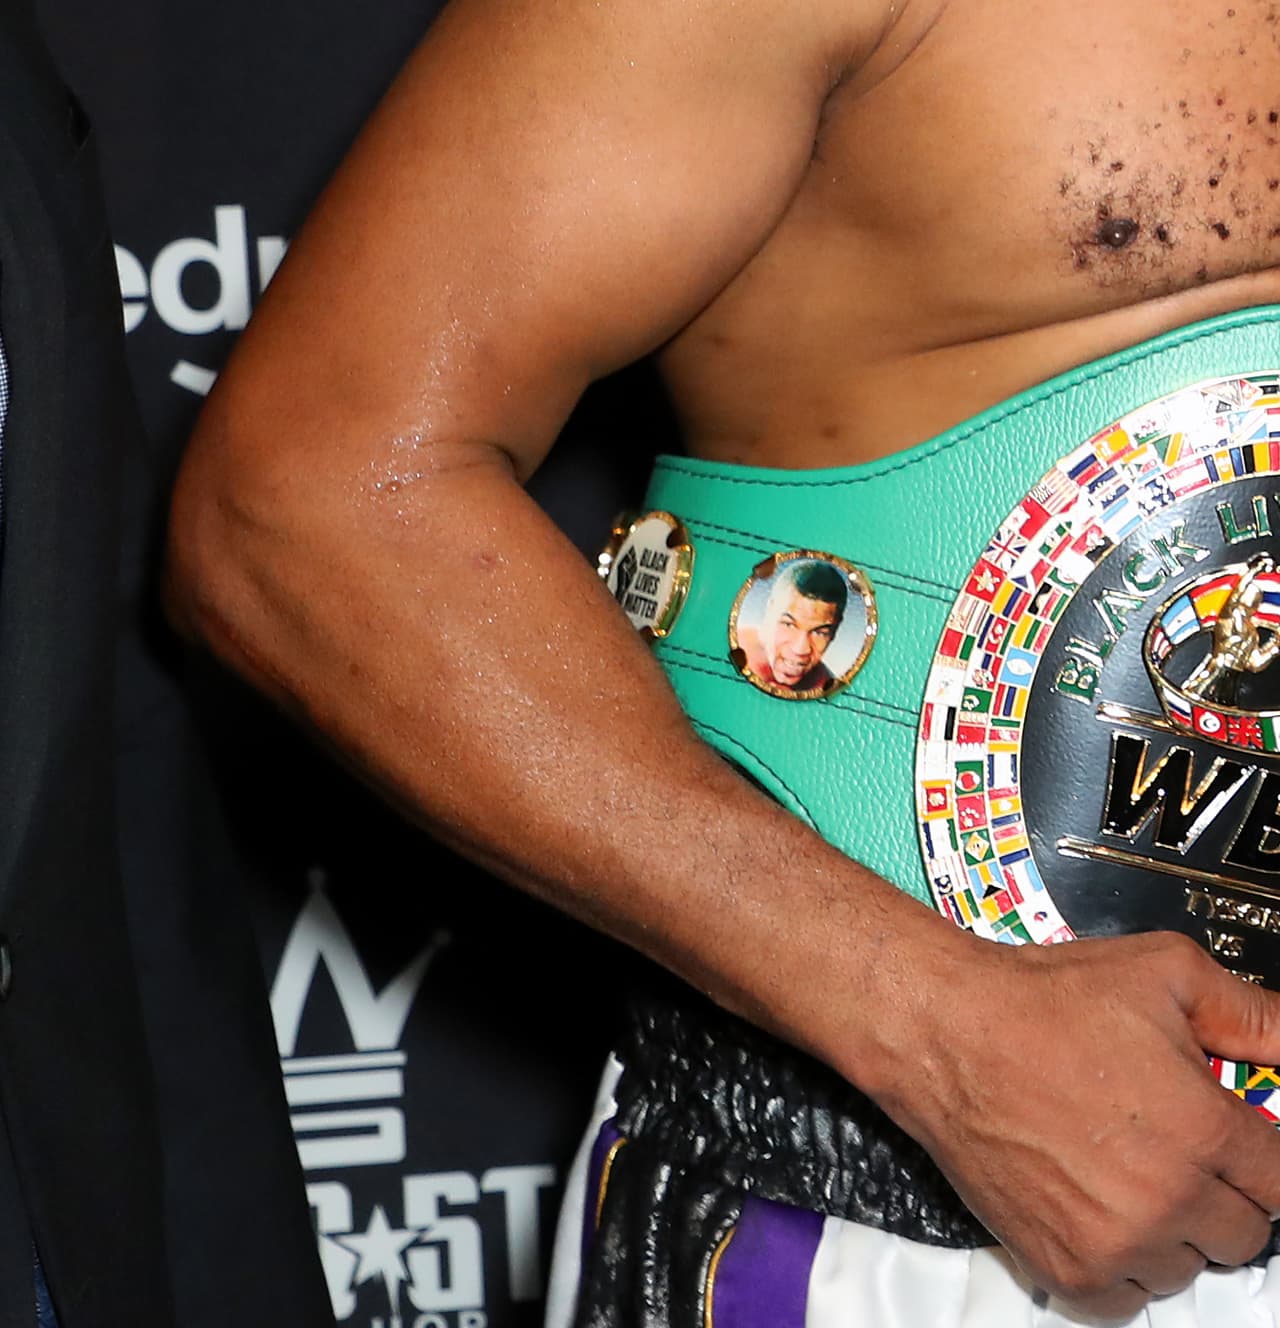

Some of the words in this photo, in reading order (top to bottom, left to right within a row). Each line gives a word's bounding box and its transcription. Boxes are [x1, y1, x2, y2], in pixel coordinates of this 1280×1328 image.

[634, 572, 661, 596] LIVES
[623, 592, 659, 621] MATTER
[1052, 518, 1212, 705] BLACK
